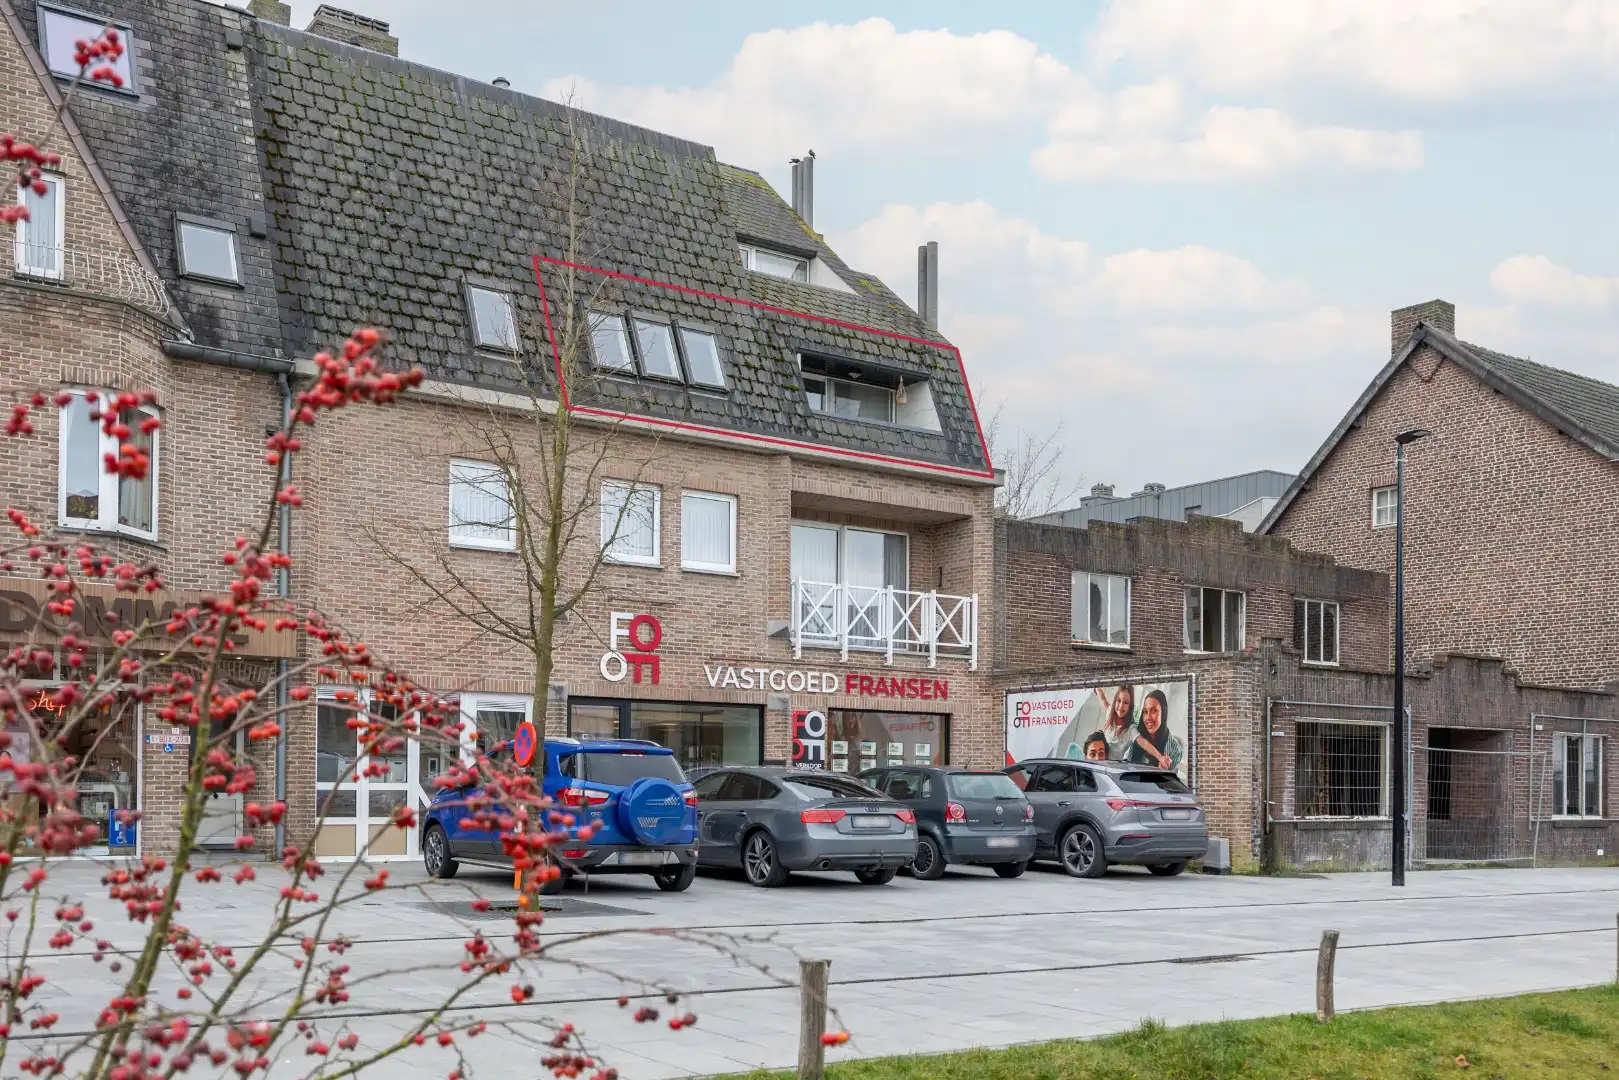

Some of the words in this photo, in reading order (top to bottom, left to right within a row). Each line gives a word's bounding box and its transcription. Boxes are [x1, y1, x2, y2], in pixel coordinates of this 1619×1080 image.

[704, 665, 839, 693] VASTGOED
[846, 674, 949, 700] FRANSEN
[1031, 699, 1074, 711] VASTGOED
[1031, 716, 1068, 727] FRANSEN
